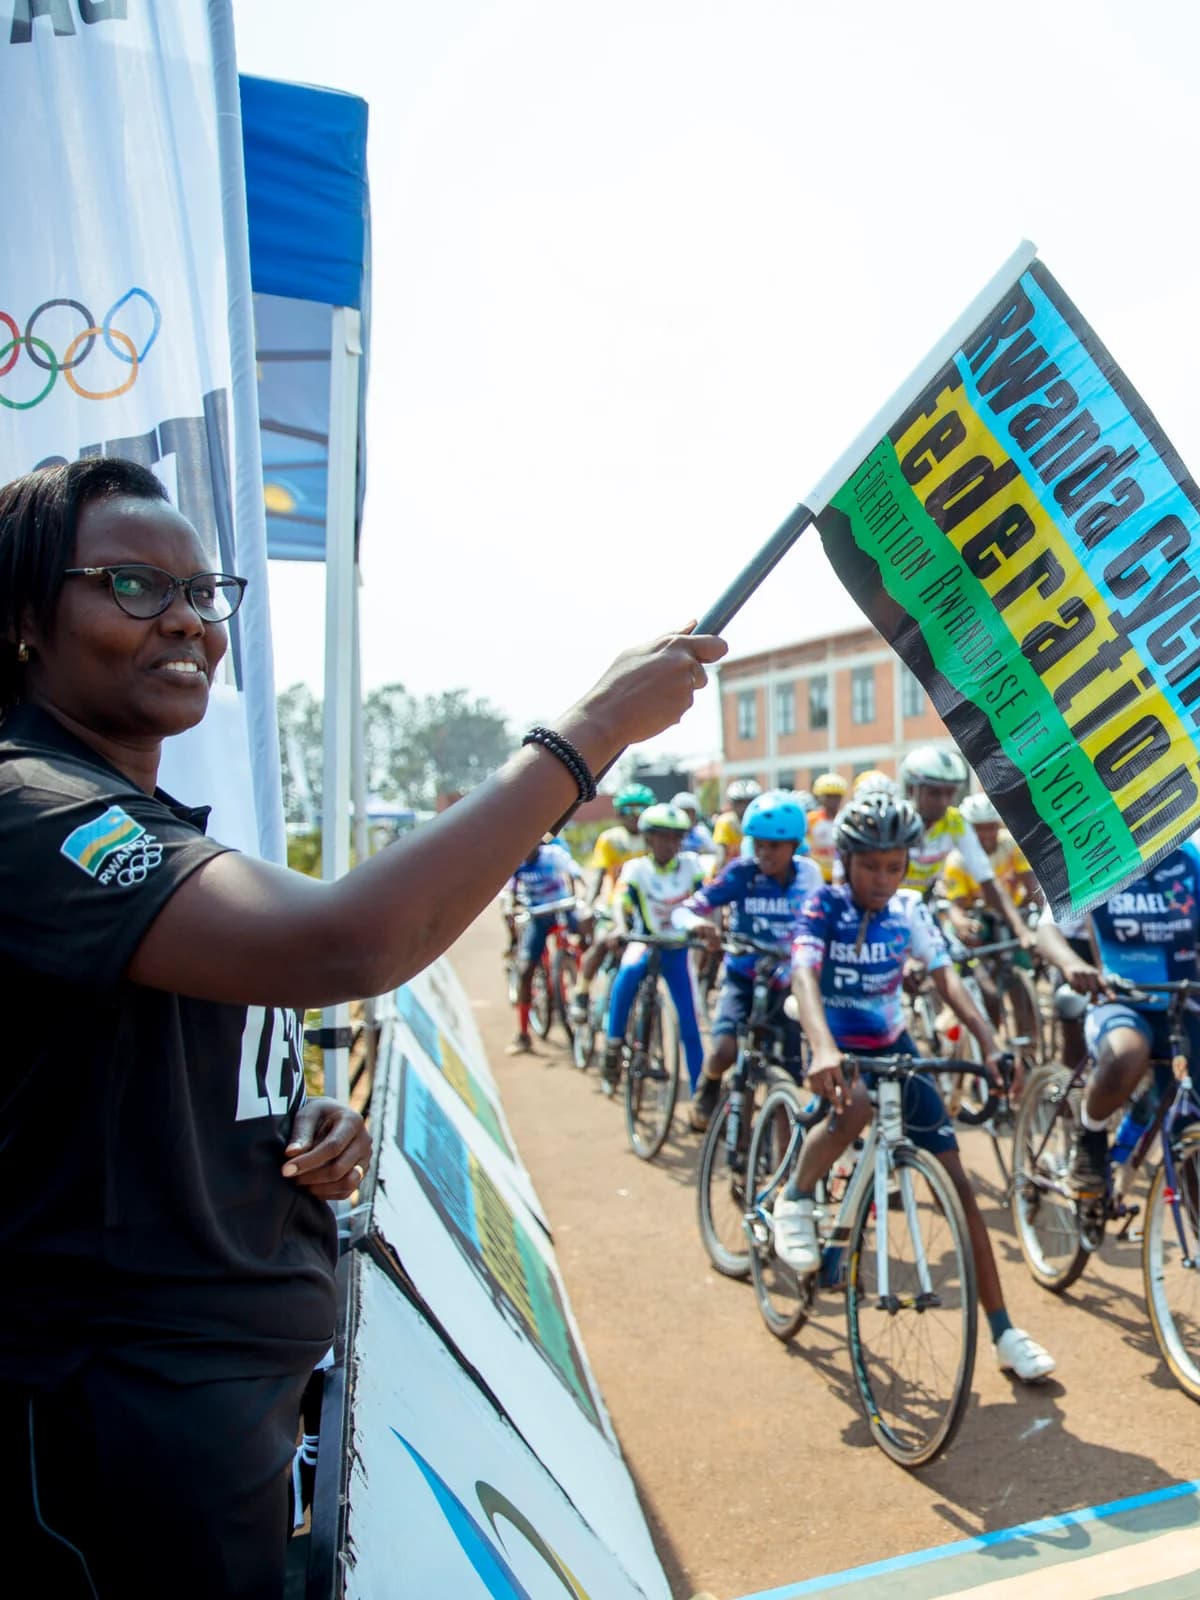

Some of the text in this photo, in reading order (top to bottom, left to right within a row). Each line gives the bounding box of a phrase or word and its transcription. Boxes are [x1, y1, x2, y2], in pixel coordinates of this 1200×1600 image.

[967, 282, 1145, 551] Rwanda
[887, 357, 1199, 848] Federation
[98, 833, 157, 886] RWANDA
[1107, 892, 1170, 914] ISRAEL
[829, 940, 888, 964] ISRAEL
